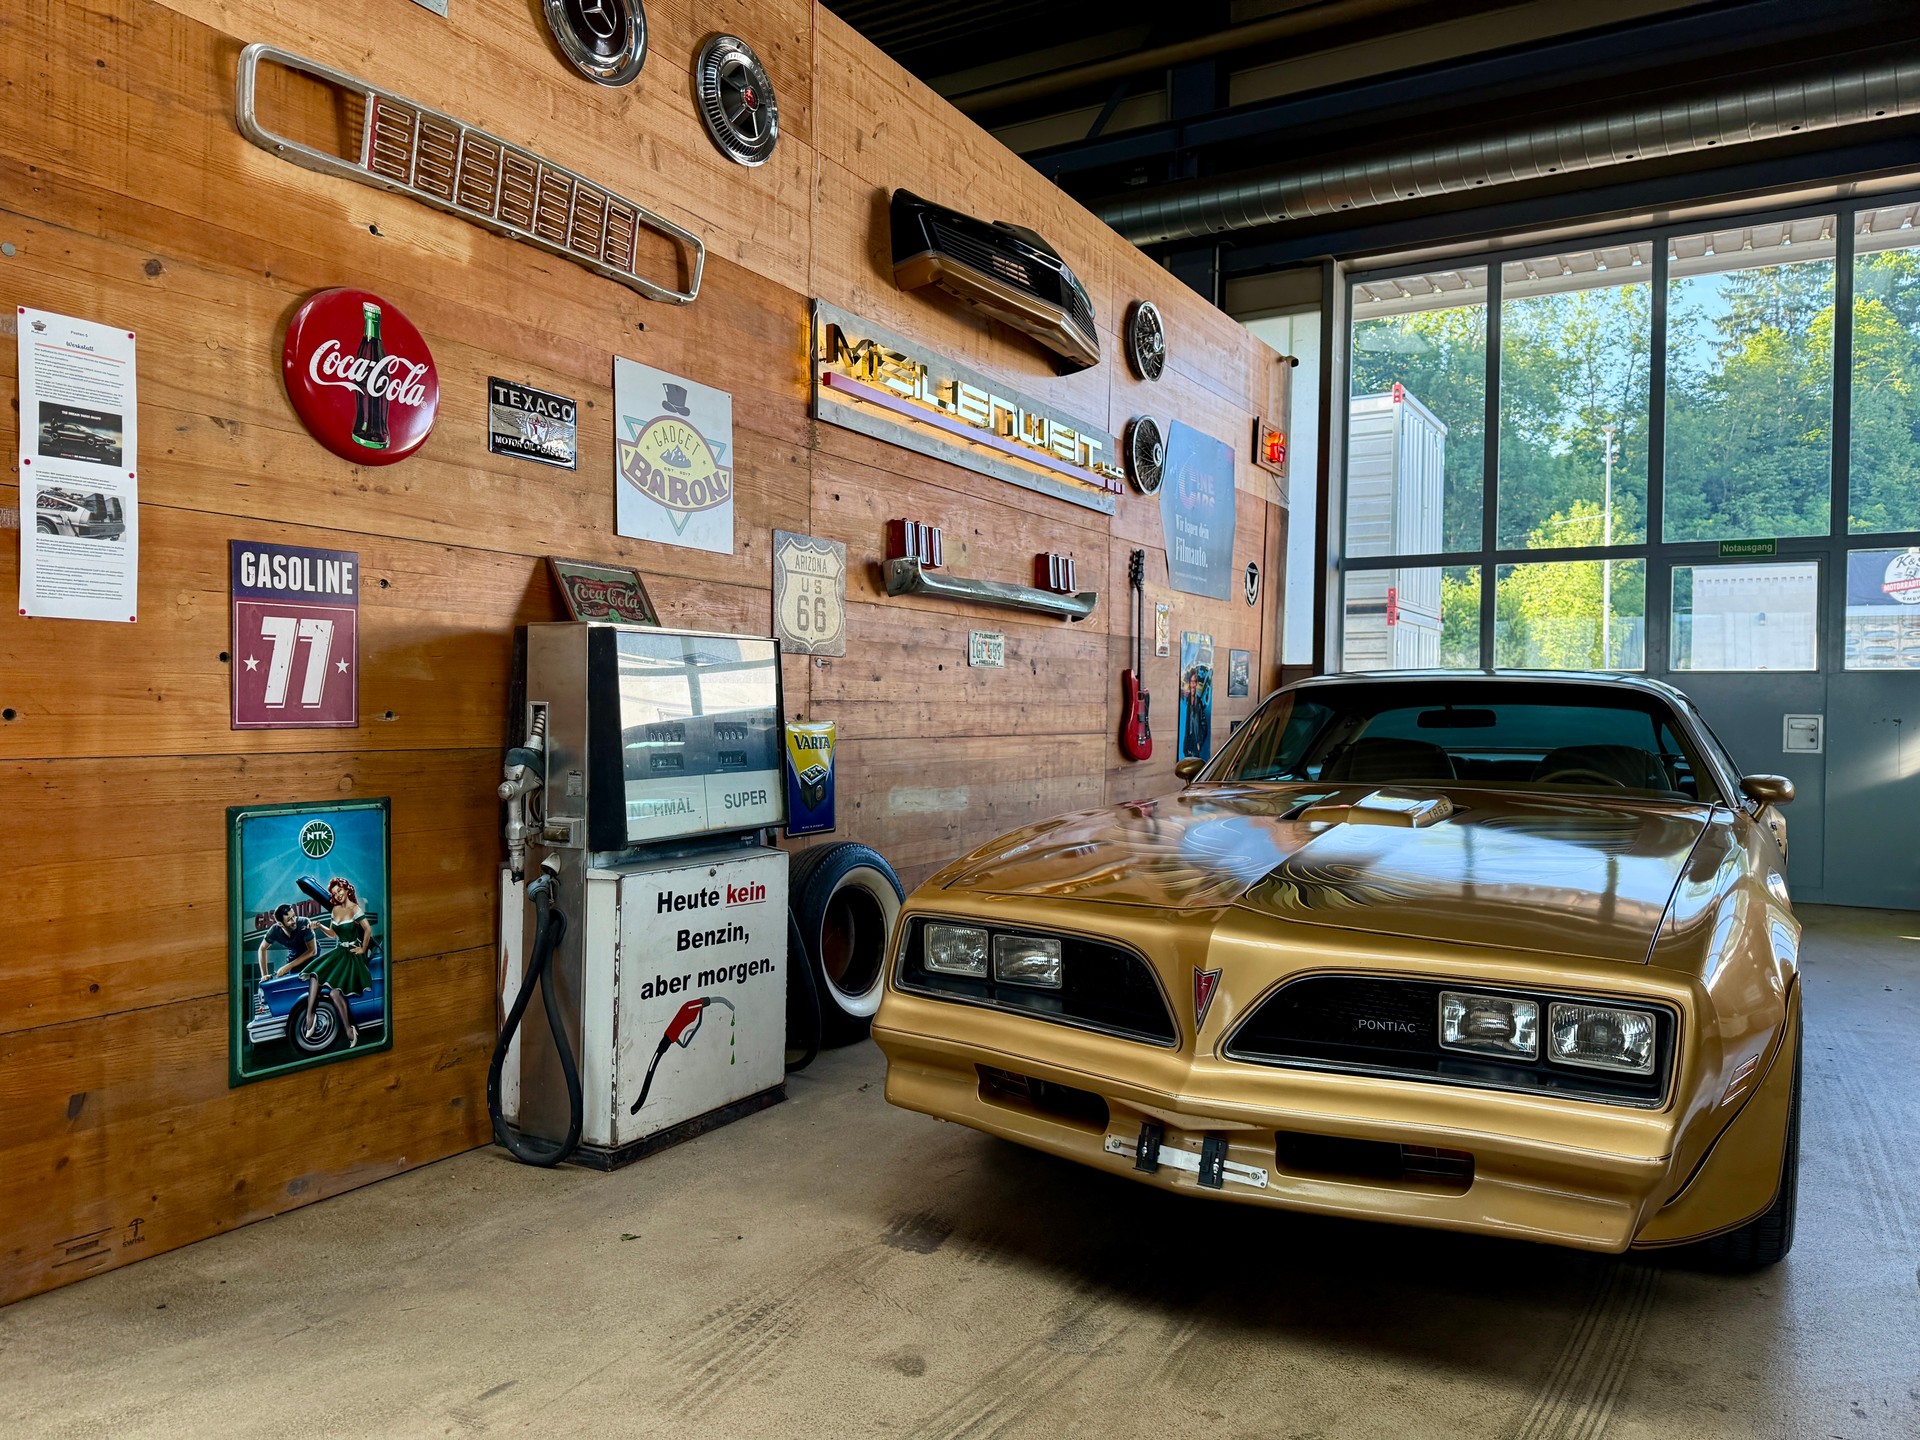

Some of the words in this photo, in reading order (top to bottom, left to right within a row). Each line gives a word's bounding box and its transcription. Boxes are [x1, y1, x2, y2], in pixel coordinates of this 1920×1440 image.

[65, 340, 95, 352] Werkstatt
[308, 339, 430, 407] Coca-Cola
[494, 385, 575, 422] TEXACO
[494, 434, 523, 450] MOTOR
[523, 441, 536, 452] OIL
[652, 425, 701, 456] GADGET
[624, 448, 728, 507] BARON
[794, 554, 828, 574] ARIZONA
[1722, 544, 1773, 554] Notausgang
[240, 551, 354, 595] GASOLINE
[796, 594, 827, 633] 66
[793, 733, 831, 750] VARTA
[629, 797, 696, 817] NORMAL
[723, 789, 768, 809] SUPER
[306, 830, 329, 842] NTK
[657, 887, 720, 914] Heute
[726, 881, 766, 906] kein
[676, 922, 749, 952] Benzin,
[640, 974, 692, 1001] aber
[697, 957, 776, 988] morgen.
[1358, 1019, 1416, 1033] PONTIAC
